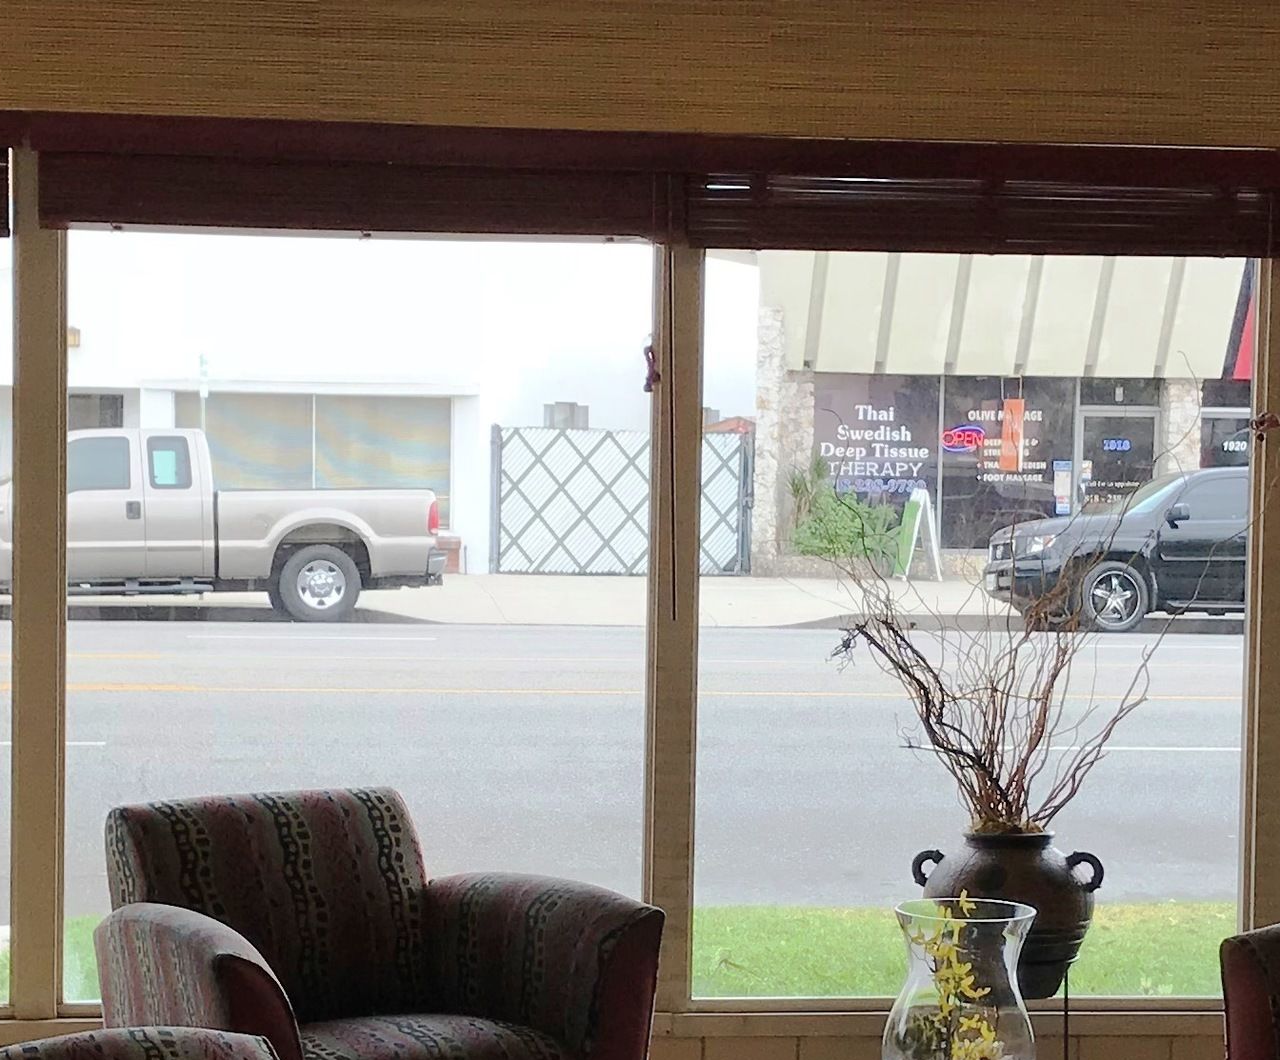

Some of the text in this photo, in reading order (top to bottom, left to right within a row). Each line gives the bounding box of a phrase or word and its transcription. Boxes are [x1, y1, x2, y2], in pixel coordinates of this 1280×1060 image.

[855, 405, 895, 421] Thai
[968, 411, 996, 421] OLIVE
[837, 425, 912, 441] Swedish
[942, 431, 984, 447] OPEN
[820, 442, 929, 460] Deep Tissue
[1223, 440, 1247, 451] 1920
[827, 461, 923, 477] THERAPY
[983, 474, 1004, 482] FOOT
